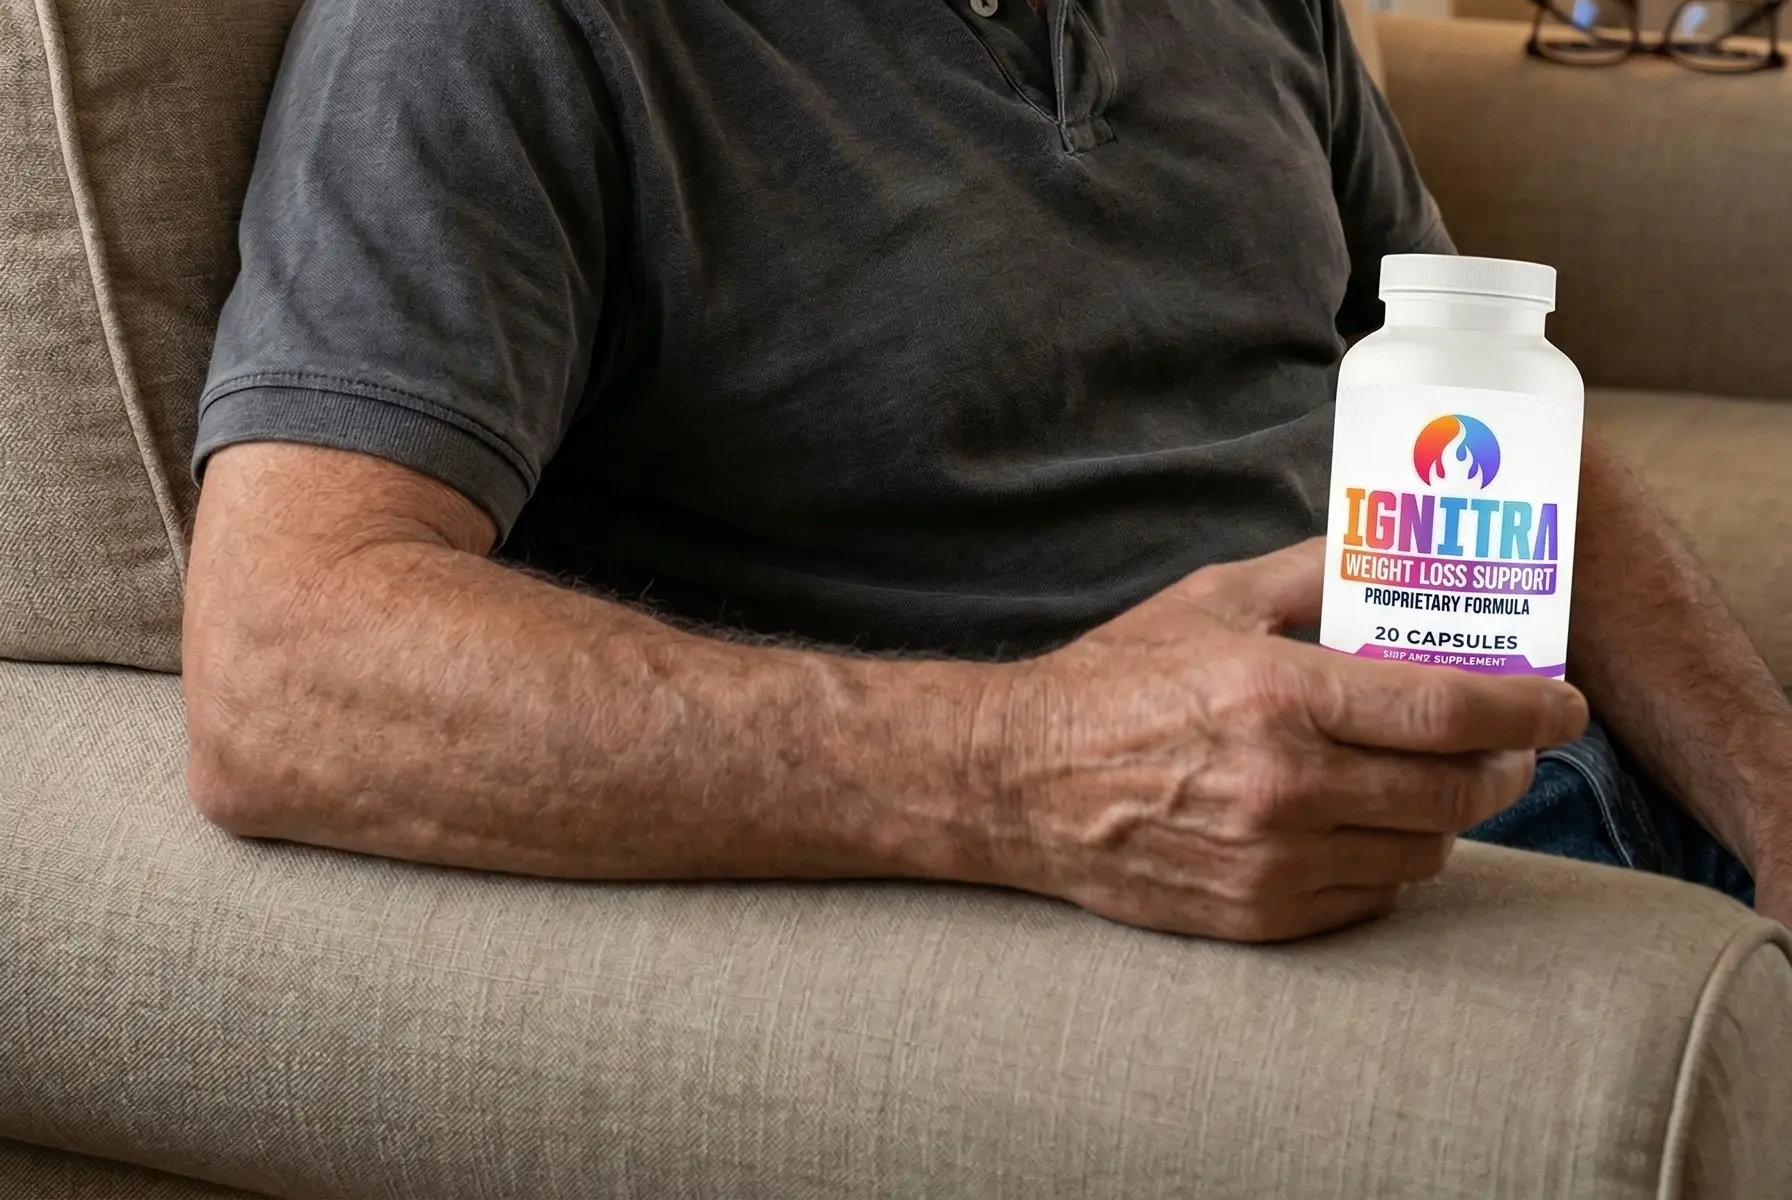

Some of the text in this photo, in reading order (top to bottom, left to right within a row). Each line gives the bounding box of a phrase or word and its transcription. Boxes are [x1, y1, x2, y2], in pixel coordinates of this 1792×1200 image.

[1343, 487, 1558, 561] IGNITRA
[1346, 553, 1554, 591] WEIGHT LOSS SUPPORT
[1364, 587, 1530, 615] PROPRIETARY FORMULA
[1375, 626, 1518, 650] 20 CAPSULES
[1433, 654, 1507, 666] SUPPLEMENT
